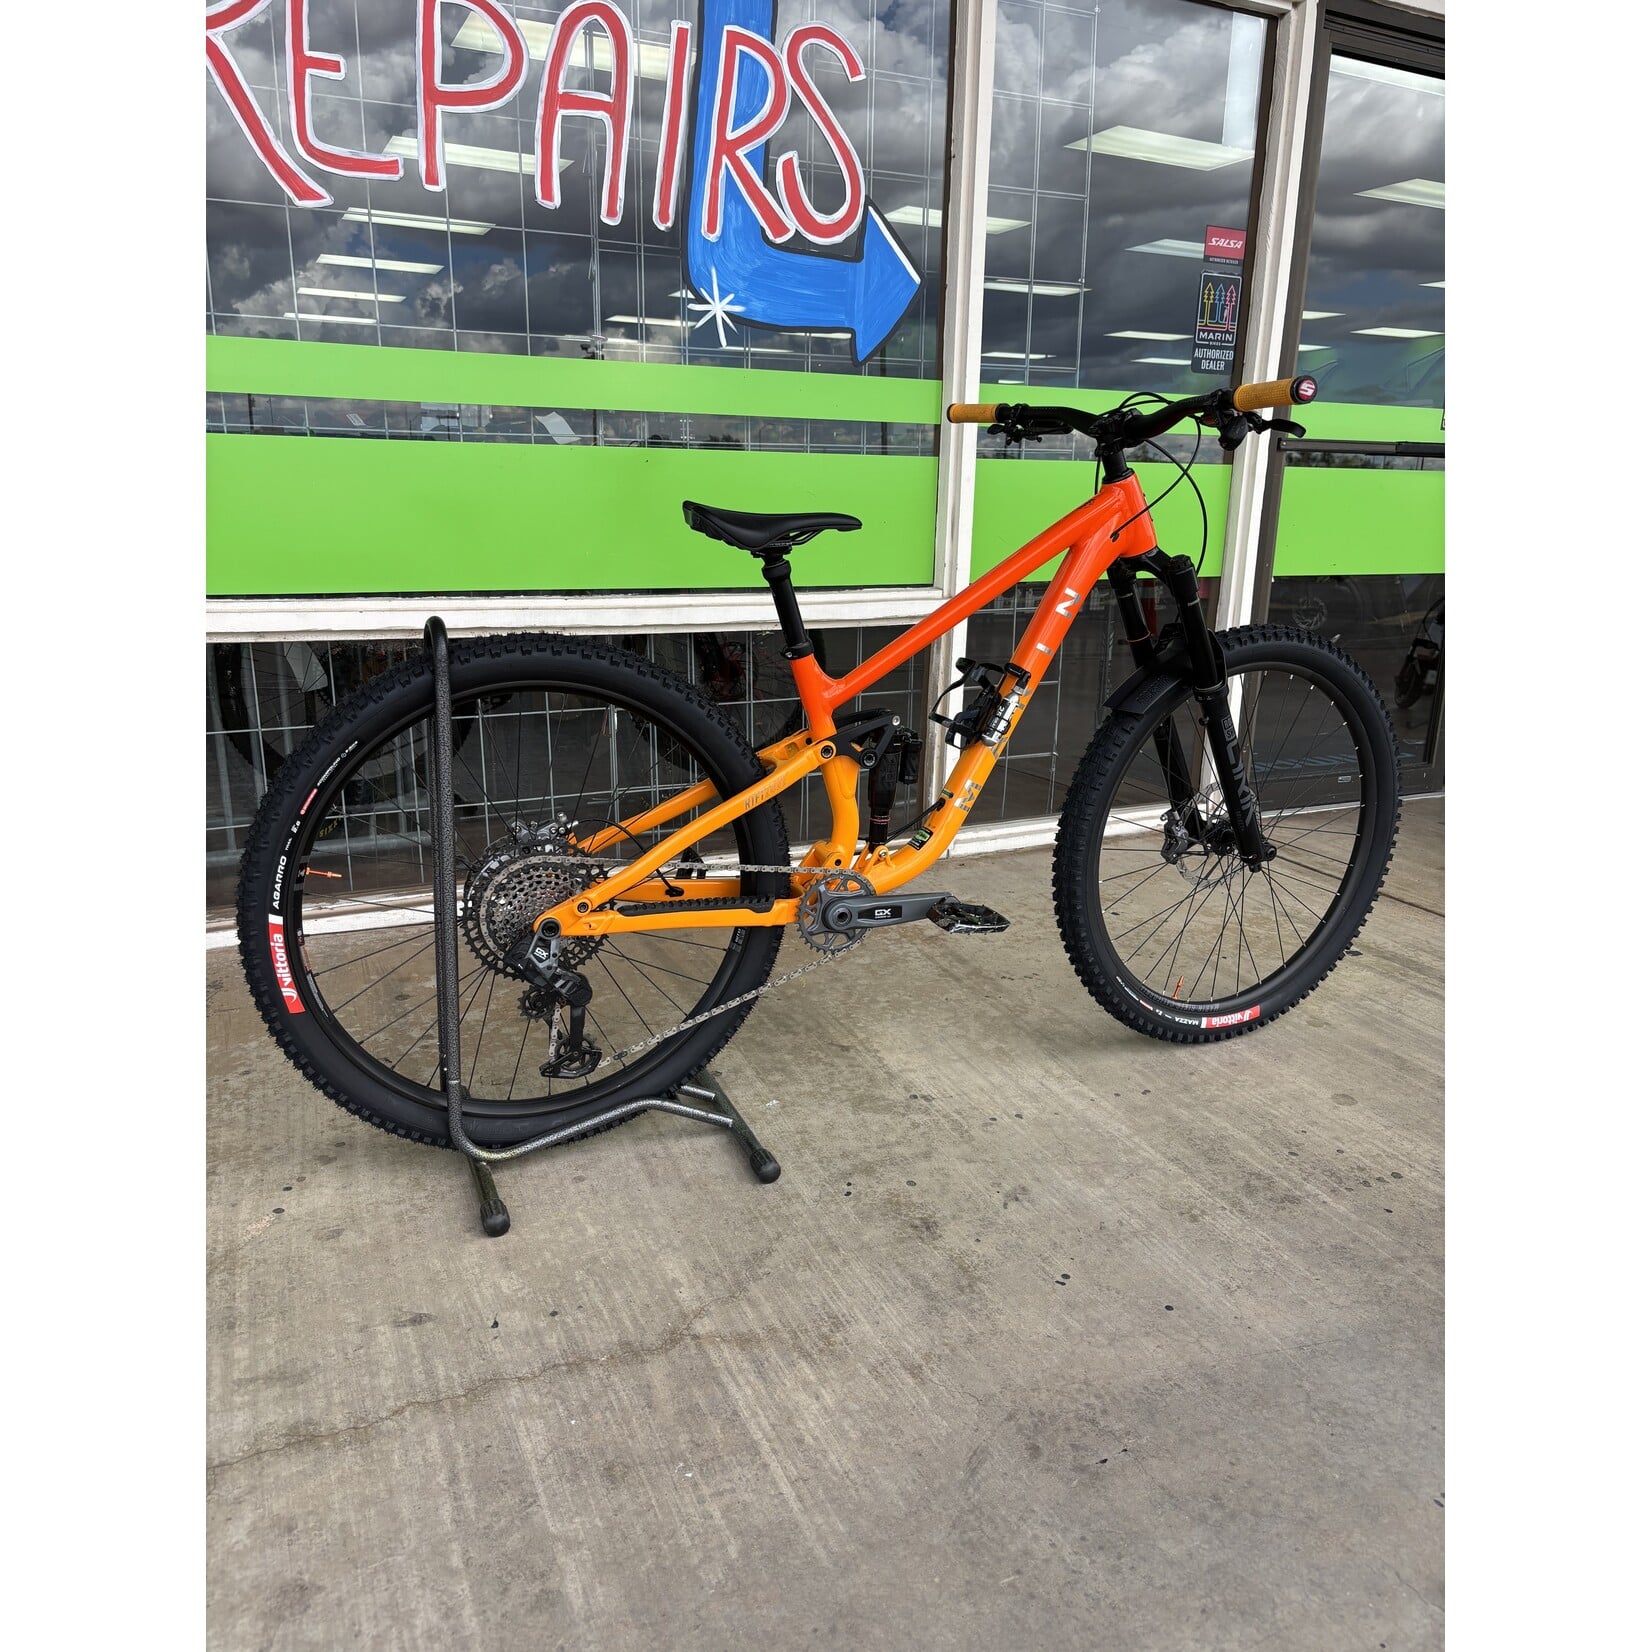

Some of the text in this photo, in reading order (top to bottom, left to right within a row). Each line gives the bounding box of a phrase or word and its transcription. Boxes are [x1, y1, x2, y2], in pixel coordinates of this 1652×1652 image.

[1208, 237, 1243, 249] SALSA
[1199, 331, 1233, 341] MARIN
[1194, 348, 1234, 360] AUTHORIZED
[1201, 360, 1225, 371] DEALER
[272, 855, 287, 909] AGARRO
[874, 908, 892, 916] GX
[535, 947, 549, 958] GX
[270, 932, 293, 987] vittoria
[1174, 1013, 1244, 1028] vittoria MAZZA
